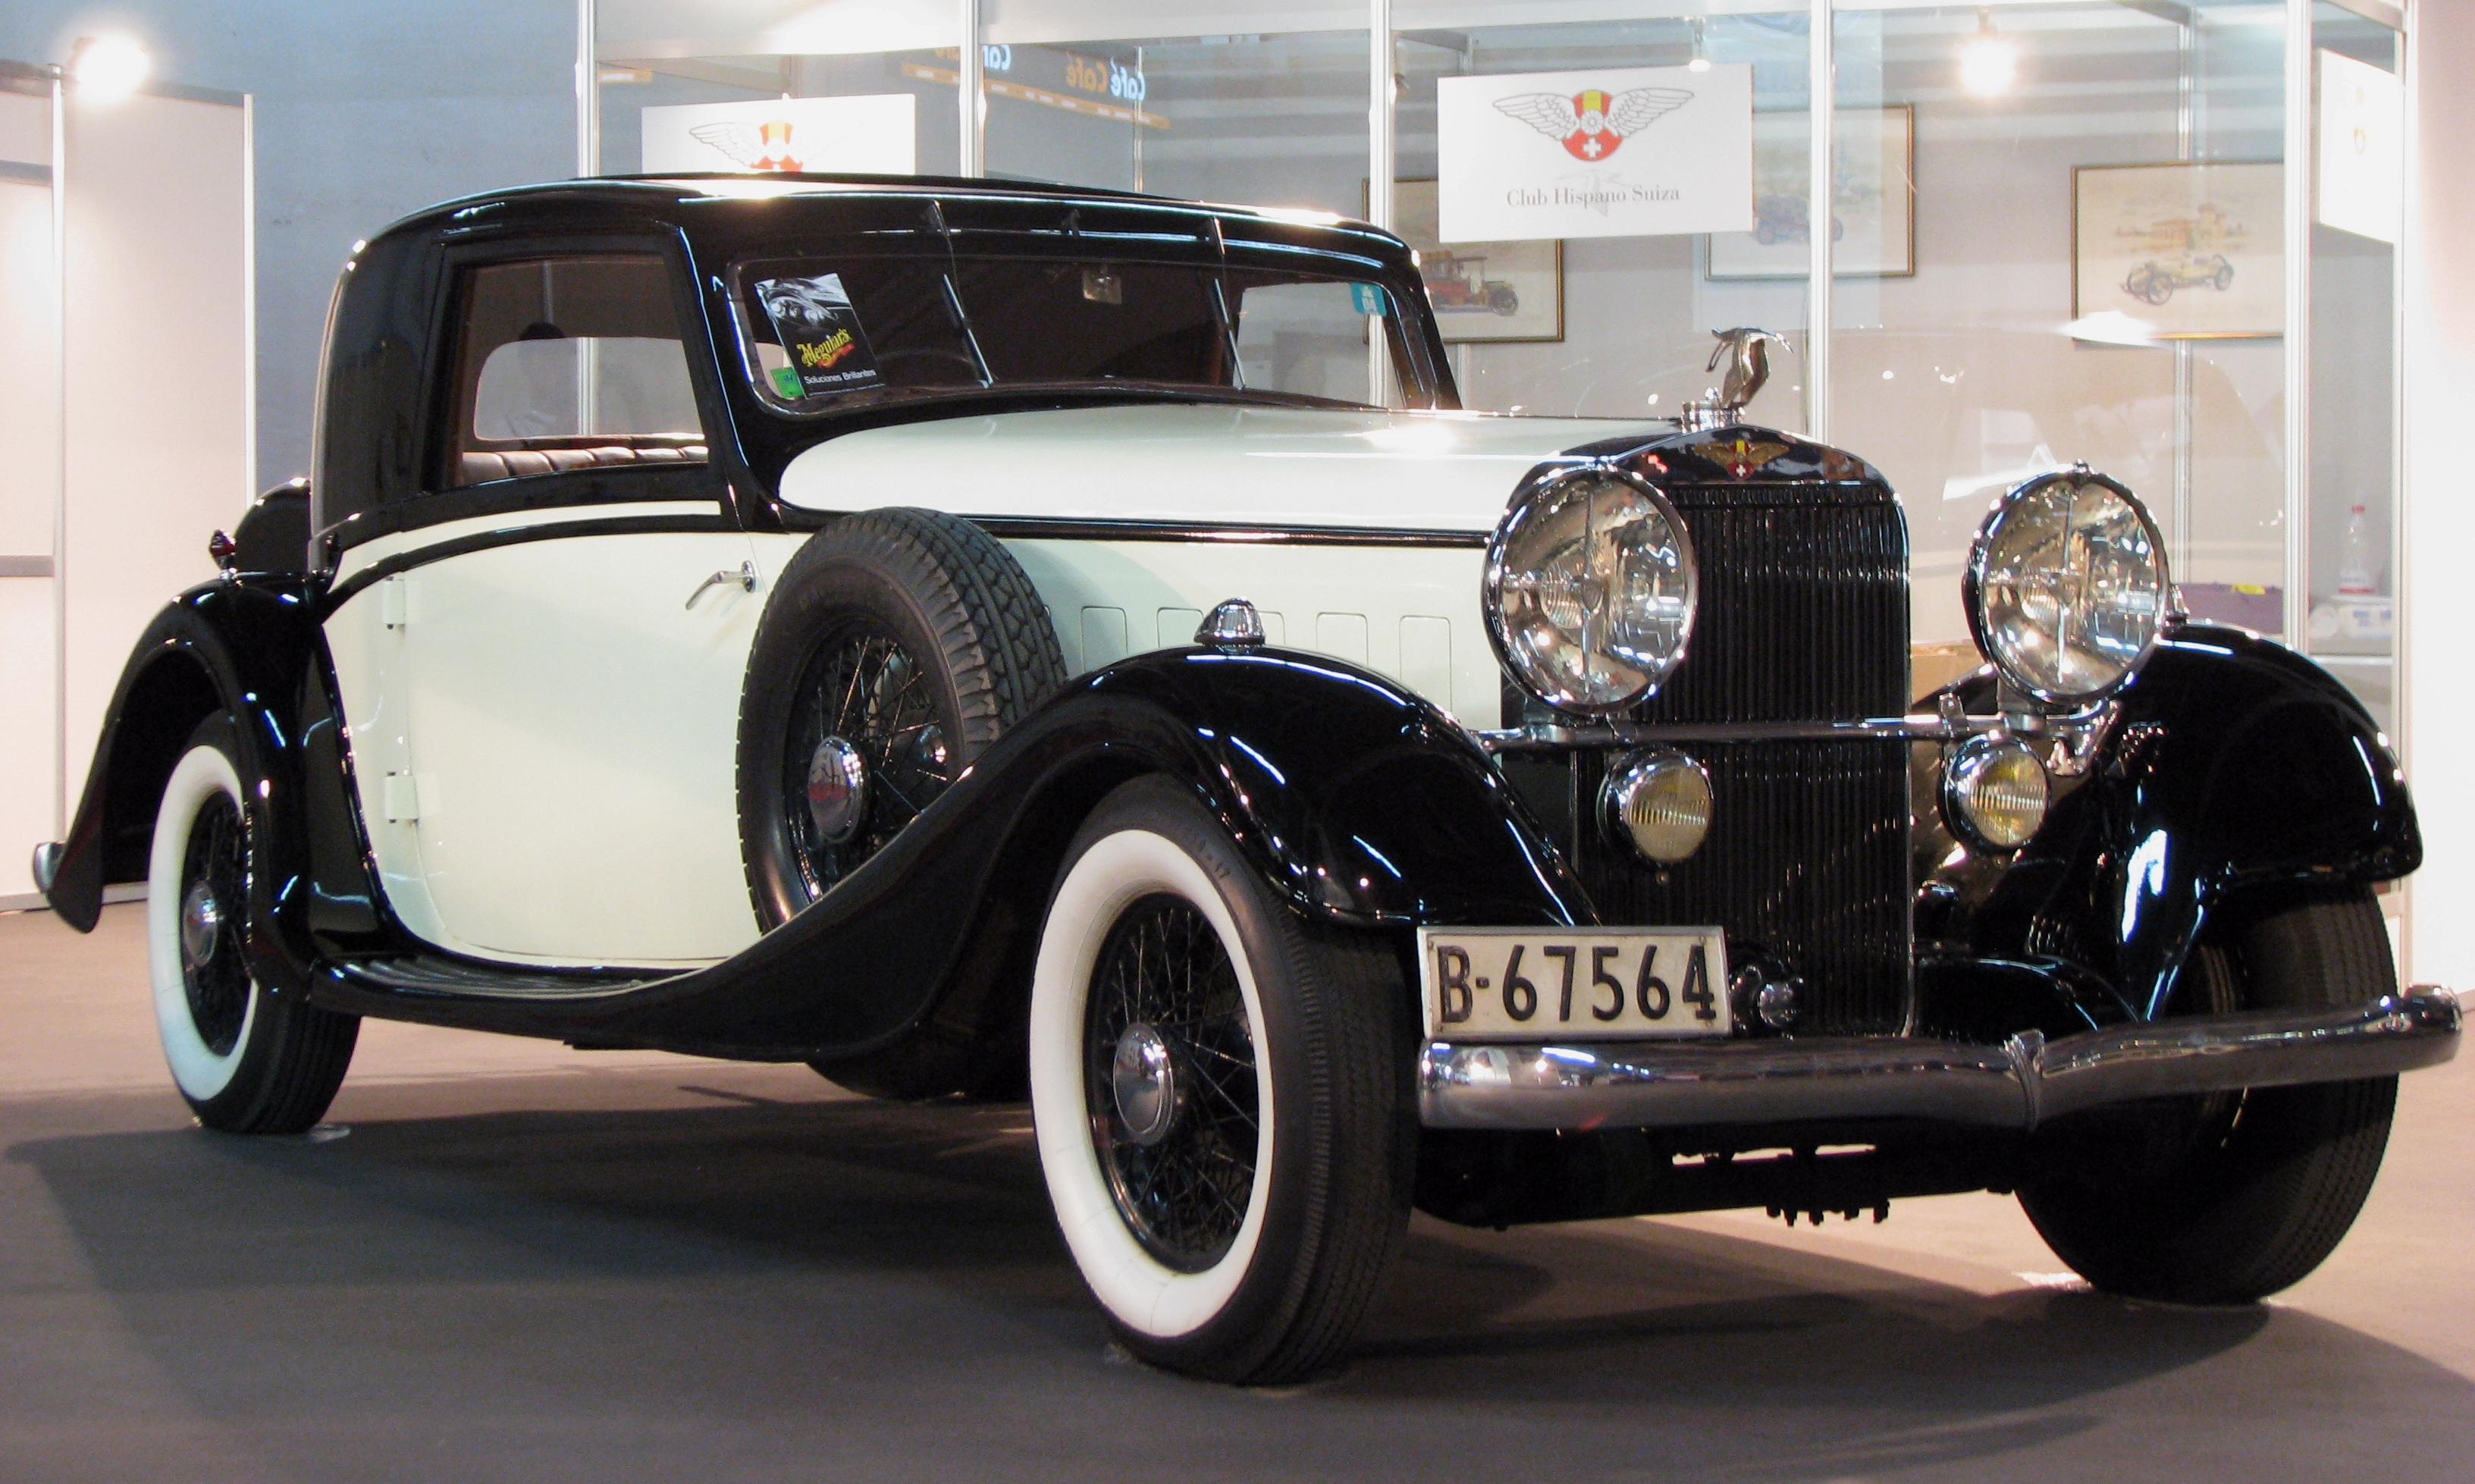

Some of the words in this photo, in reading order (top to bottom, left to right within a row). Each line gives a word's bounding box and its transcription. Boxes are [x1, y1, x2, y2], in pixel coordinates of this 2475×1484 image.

[1507, 189, 1548, 206] Club
[1554, 188, 1626, 209] Hispano
[1632, 184, 1680, 202] Suiza
[804, 374, 842, 385] Soluciones
[842, 369, 876, 381] Brillantes
[1438, 945, 1716, 1022] B-67564
